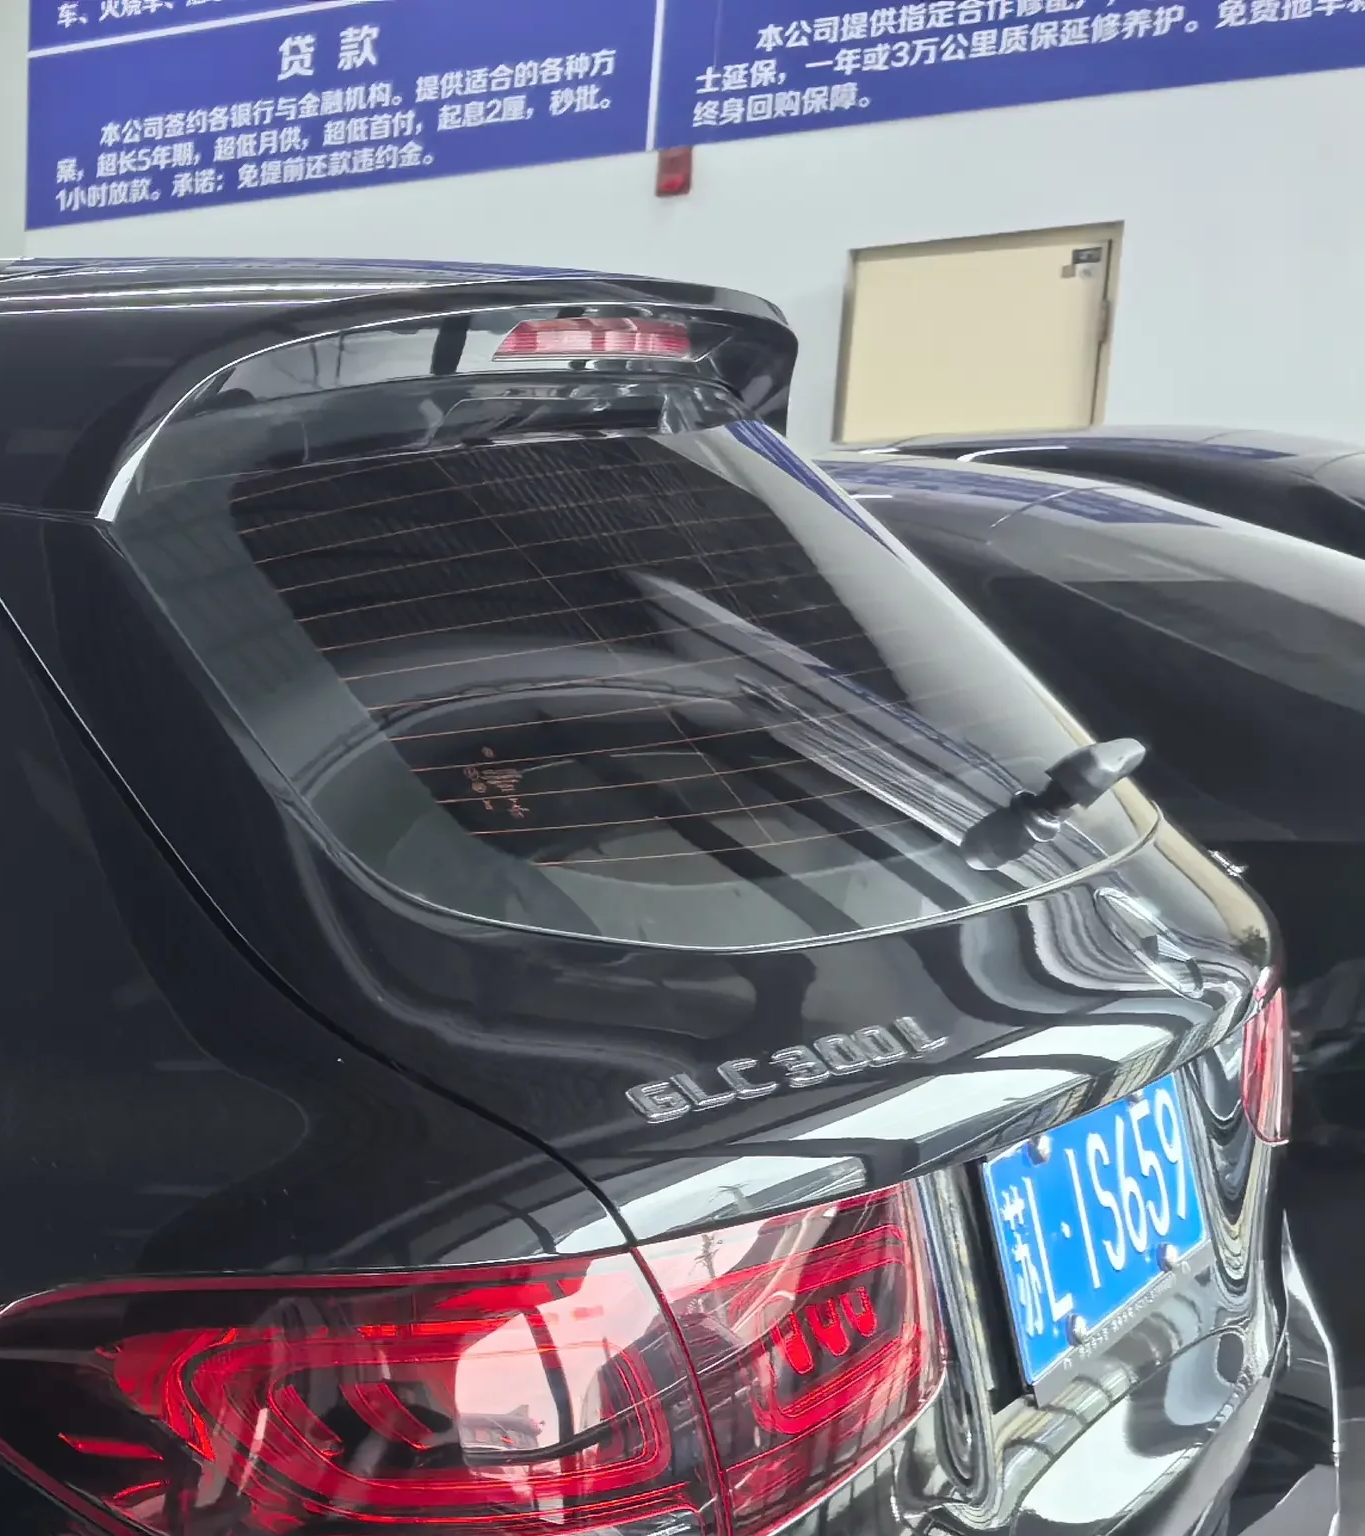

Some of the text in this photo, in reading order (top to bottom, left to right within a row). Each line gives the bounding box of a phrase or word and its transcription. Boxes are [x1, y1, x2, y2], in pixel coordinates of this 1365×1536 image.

[277, 24, 379, 81] 贷款
[692, 82, 871, 127] 终身回购保障。
